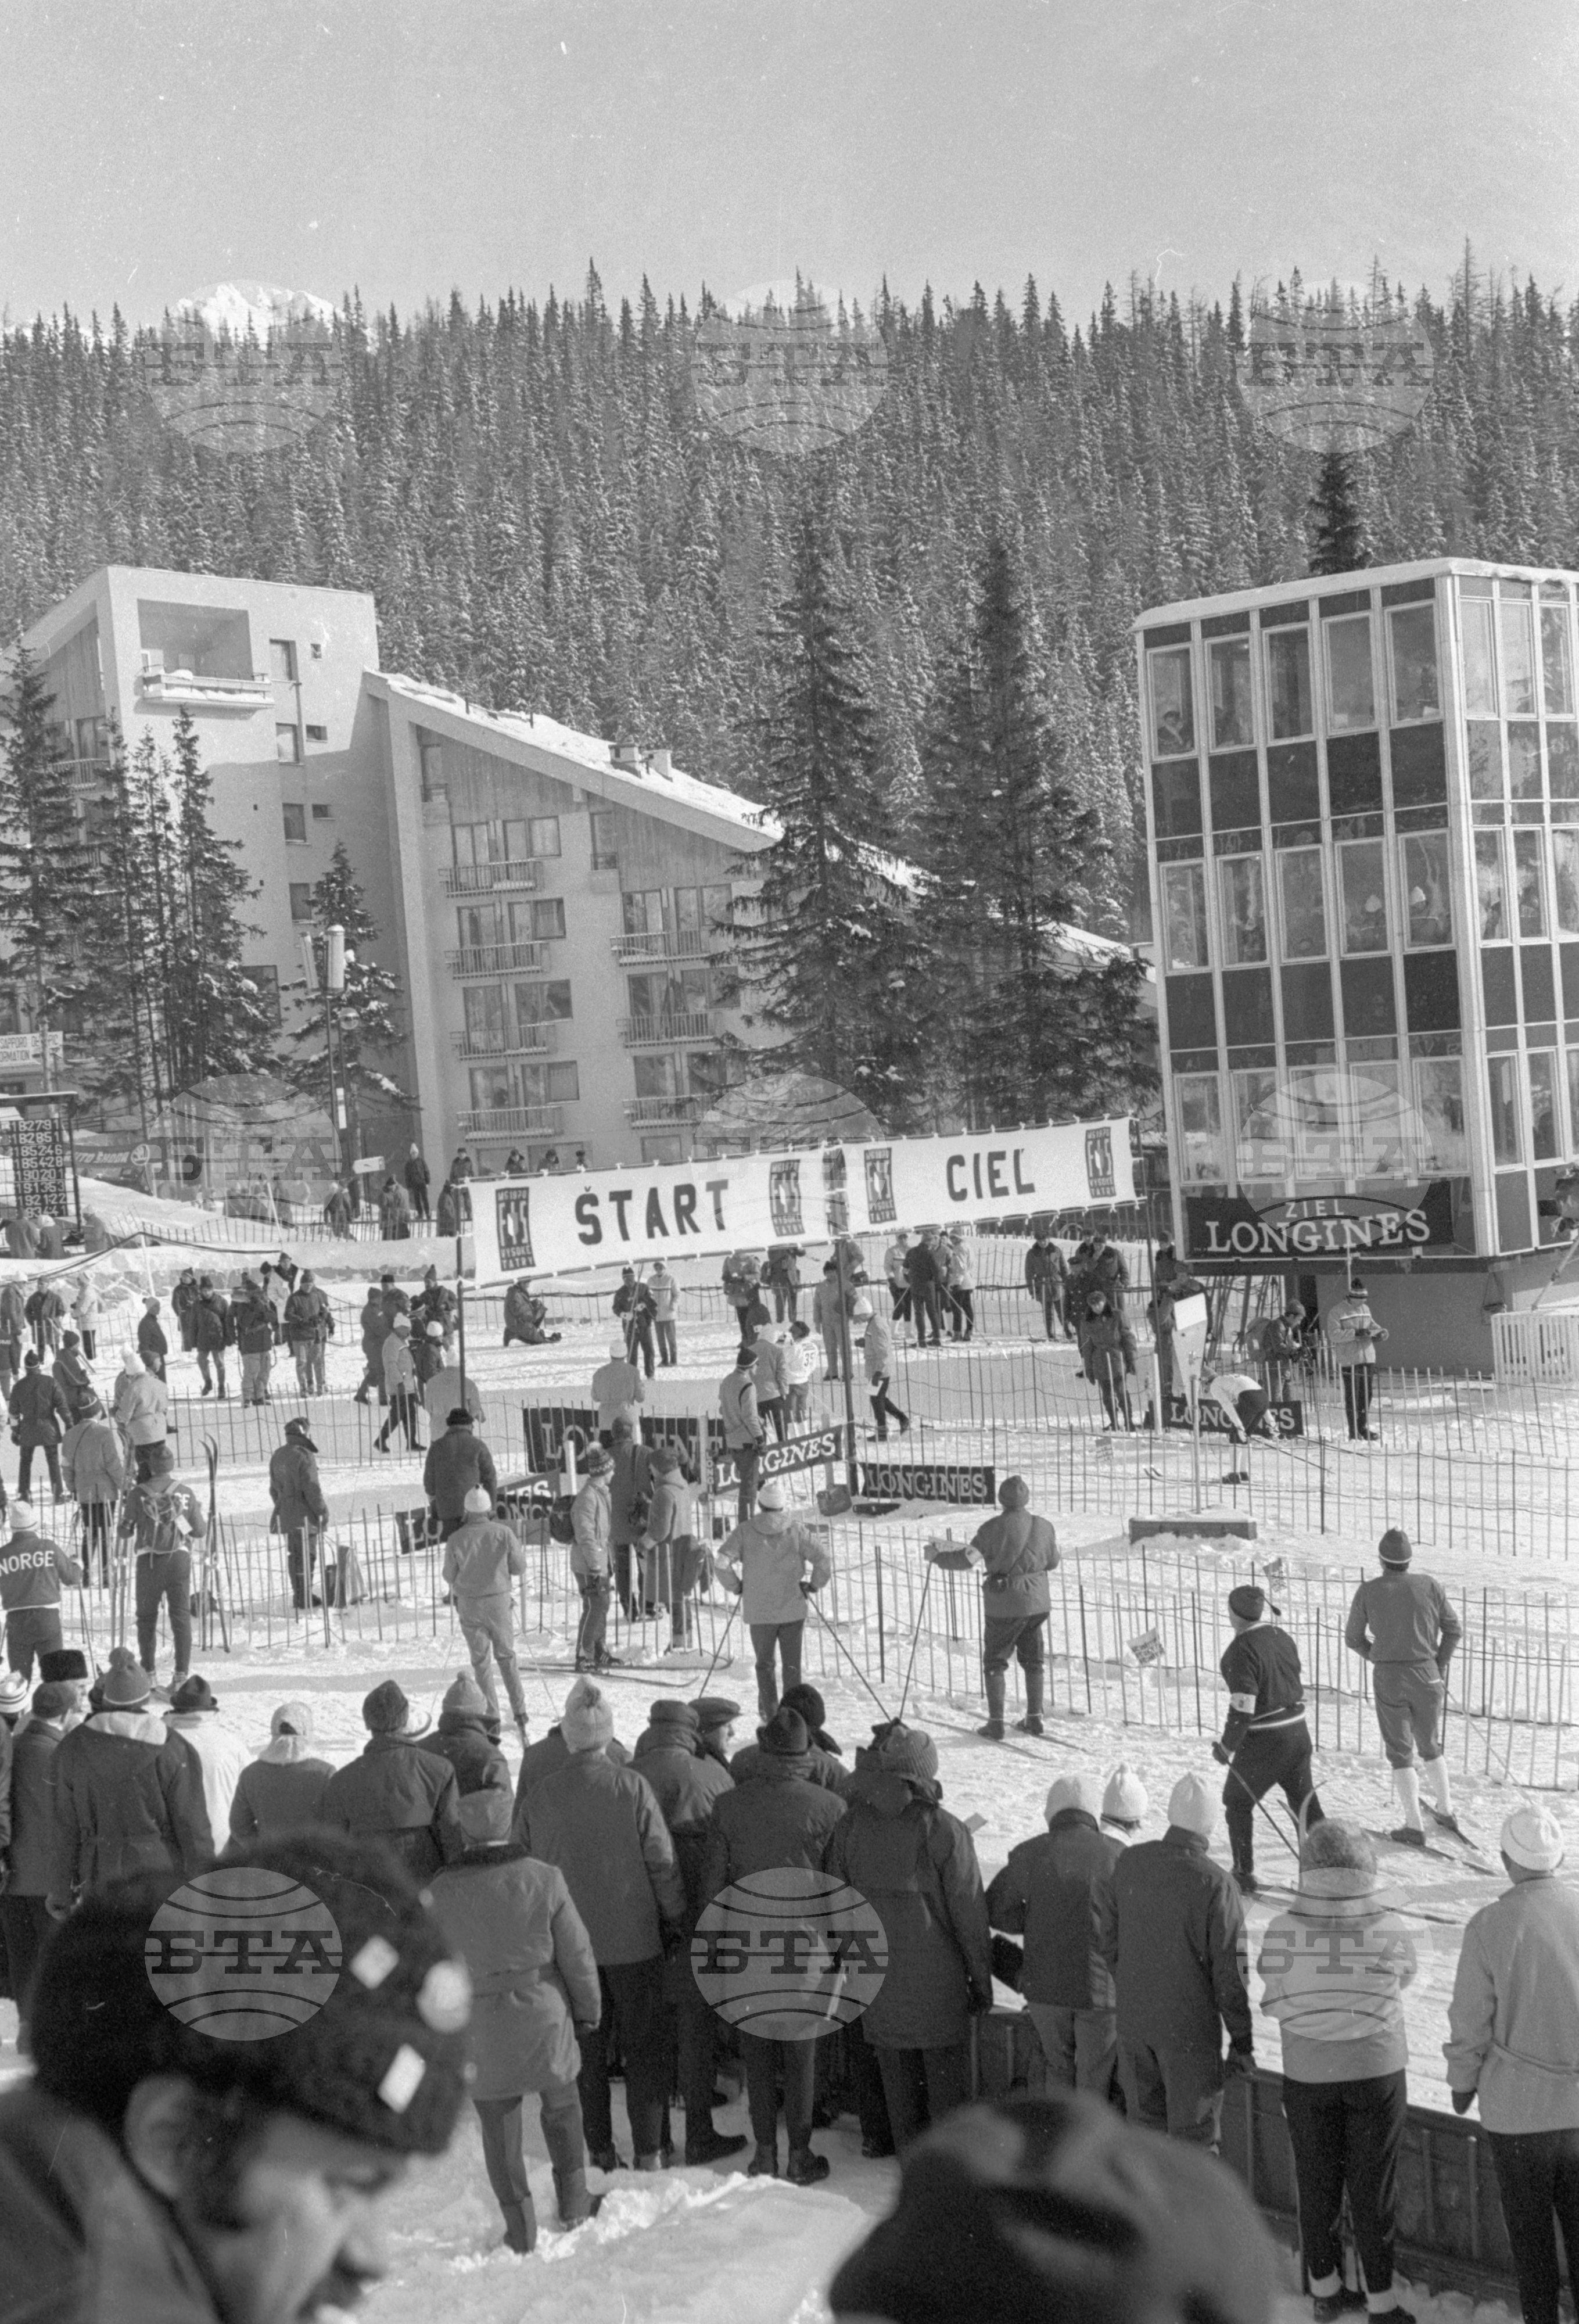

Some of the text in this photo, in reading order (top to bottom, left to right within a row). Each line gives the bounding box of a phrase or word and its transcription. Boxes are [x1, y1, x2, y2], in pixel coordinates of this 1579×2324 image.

[946, 1148, 1035, 1202] CIEL
[575, 1178, 729, 1245] ŠTART
[1285, 1199, 1344, 1218] ZIEL
[1205, 1208, 1430, 1253] LONGINES
[868, 1469, 988, 1498] LONGINES
[0, 1550, 55, 1577] NORGE
